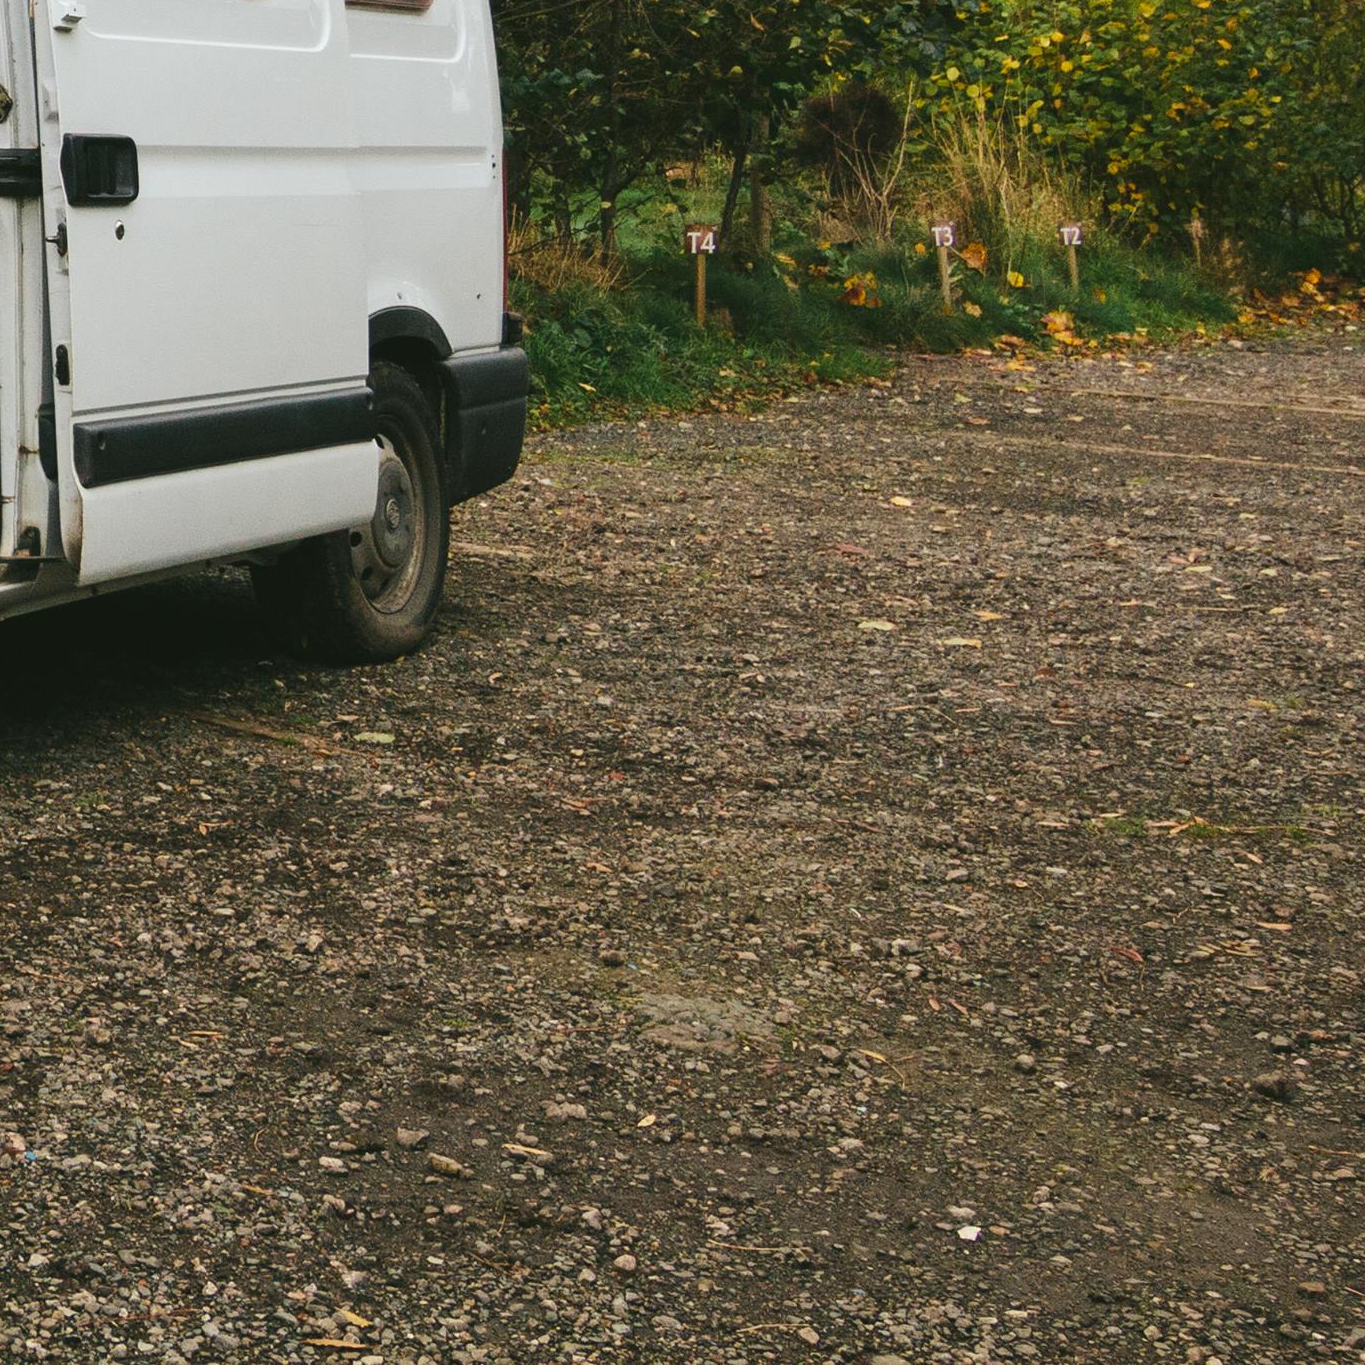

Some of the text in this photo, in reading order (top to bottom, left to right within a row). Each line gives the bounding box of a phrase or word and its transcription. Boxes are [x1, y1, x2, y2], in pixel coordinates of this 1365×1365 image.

[687, 231, 716, 254] T4
[931, 226, 953, 247] T3
[1060, 227, 1082, 245] T2
